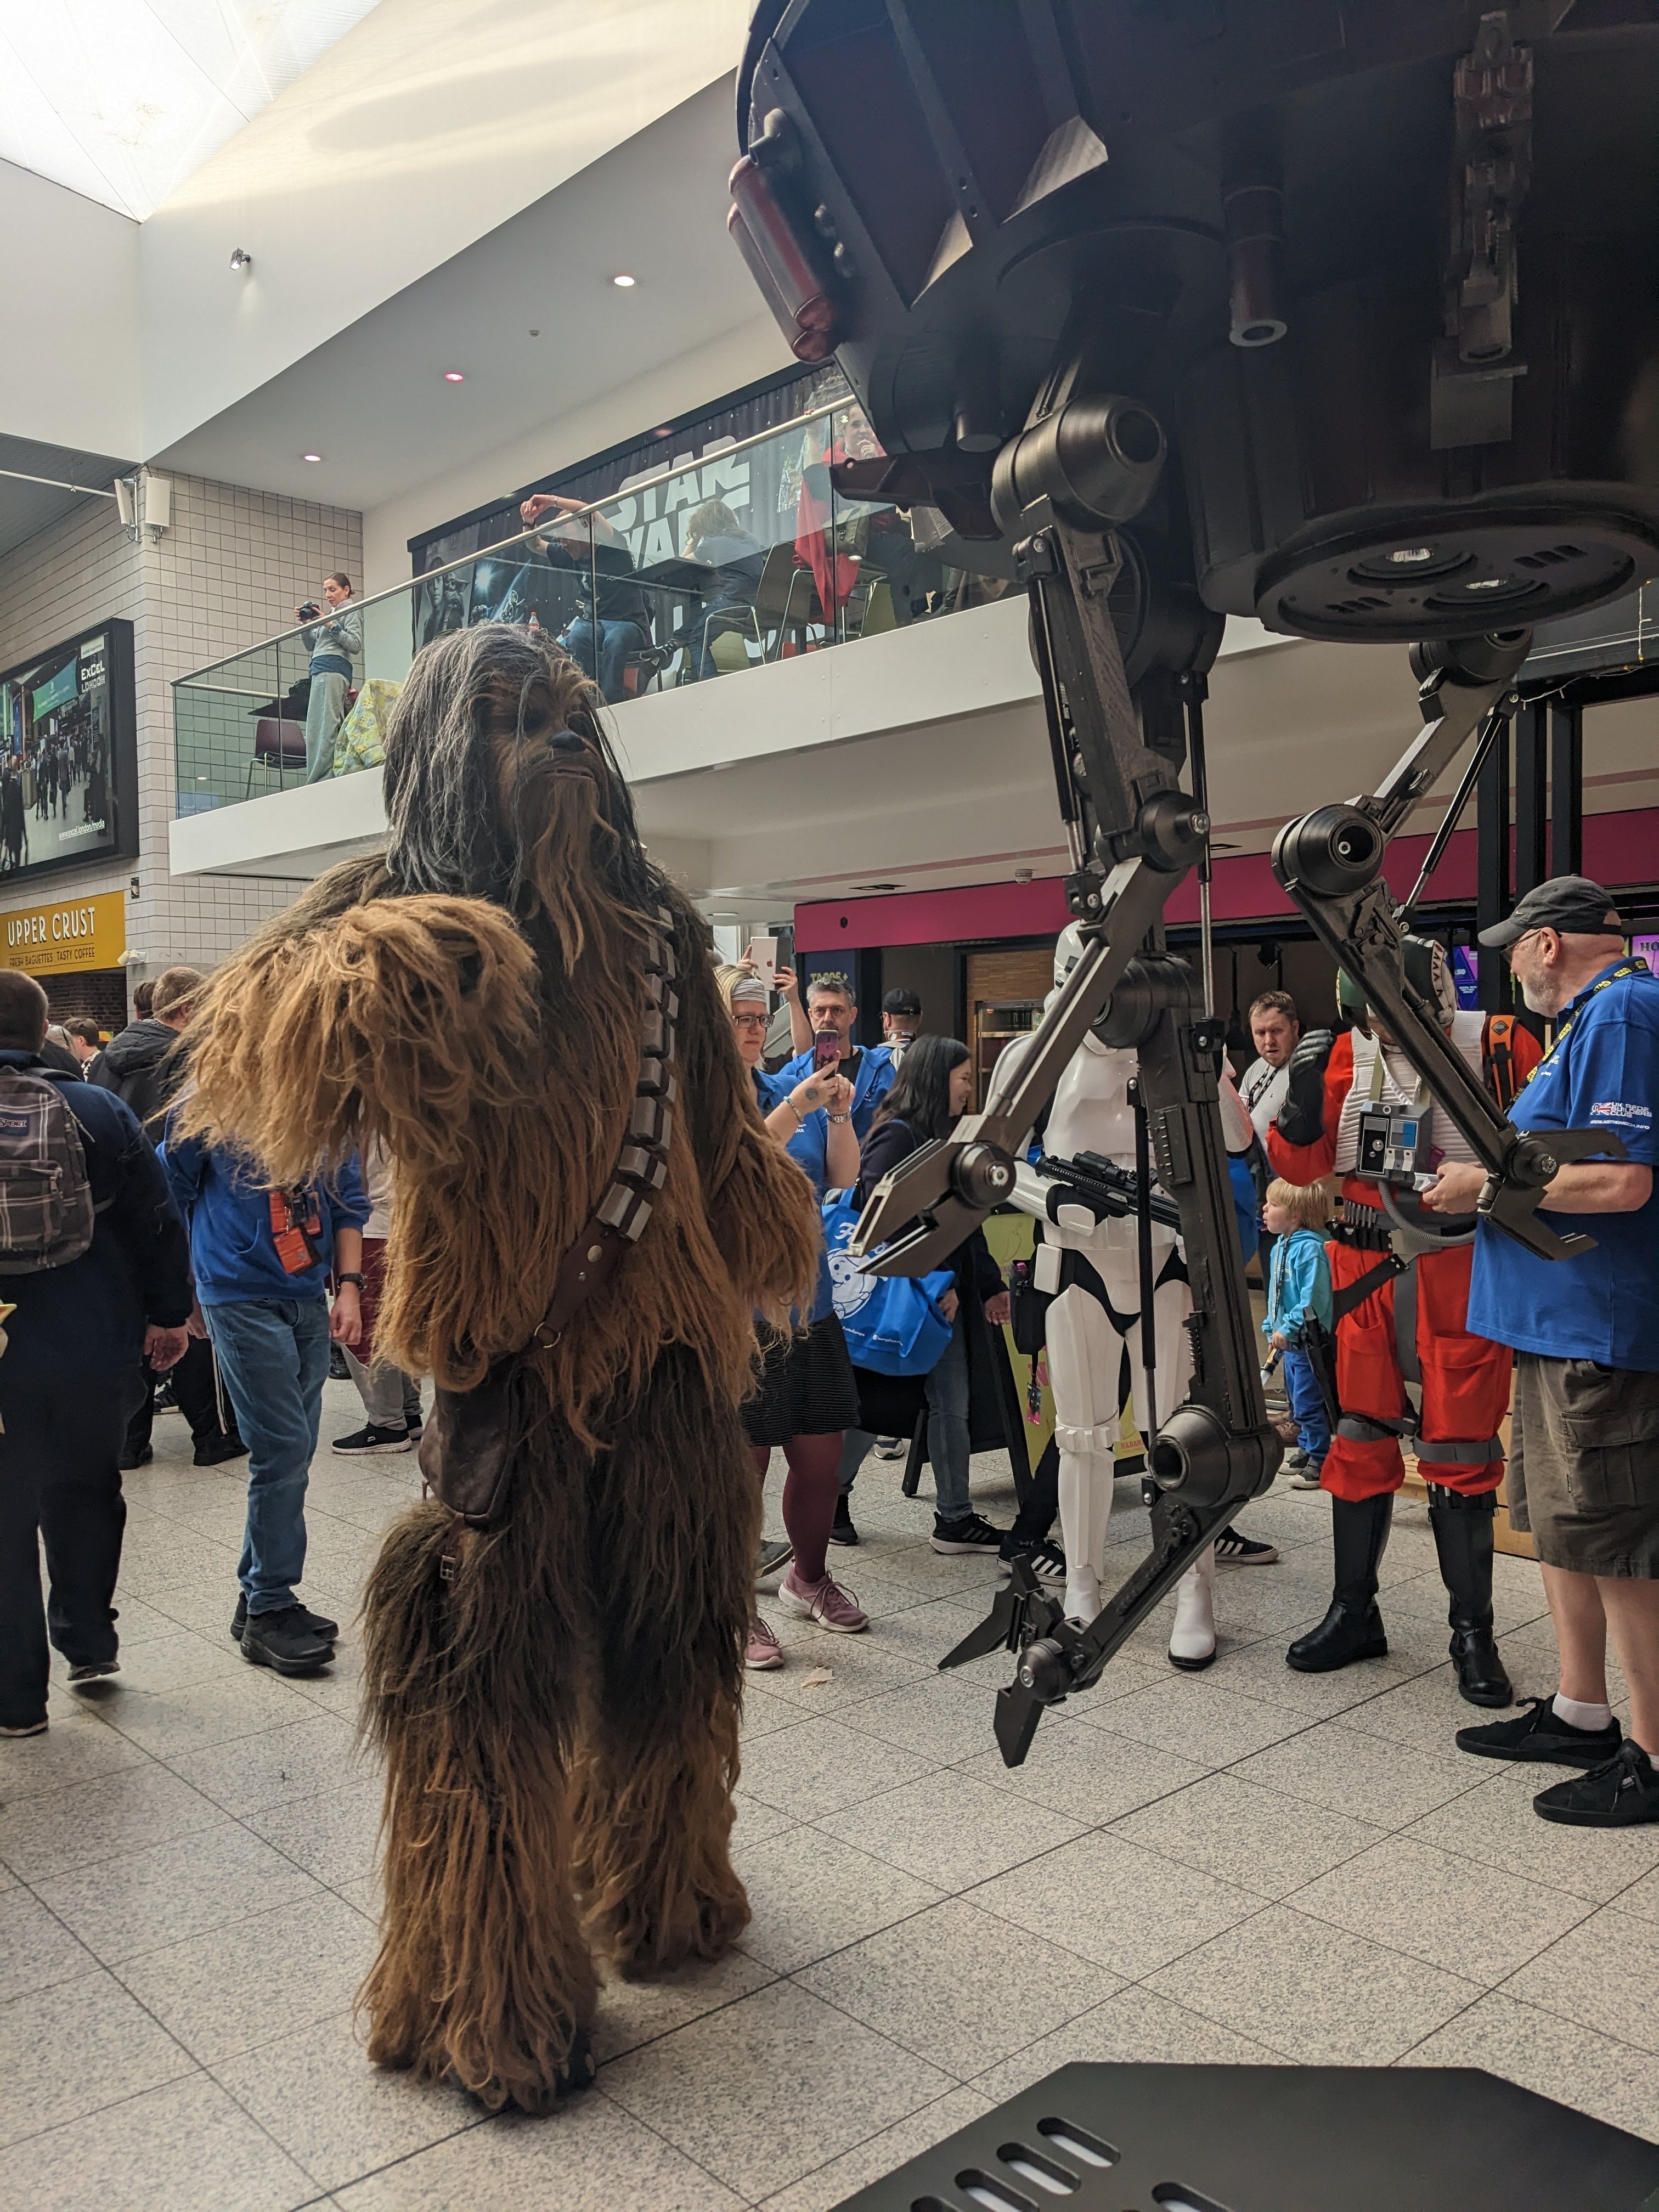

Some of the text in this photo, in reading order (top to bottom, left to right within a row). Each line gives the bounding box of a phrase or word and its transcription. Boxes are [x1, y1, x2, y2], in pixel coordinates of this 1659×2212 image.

[606, 435, 750, 532] STAR
[81, 674, 105, 693] LONDON
[8, 907, 95, 947] UPPER CRUST
[9, 957, 24, 967] FRESH
[57, 950, 72, 961] TASTY
[74, 947, 95, 960] COFFEE
[1611, 1106, 1652, 1117] BUILDERS
[1626, 1103, 1649, 1112] R2D2
[1590, 1120, 1650, 1130] WWW.ASTROMECH.INFO
